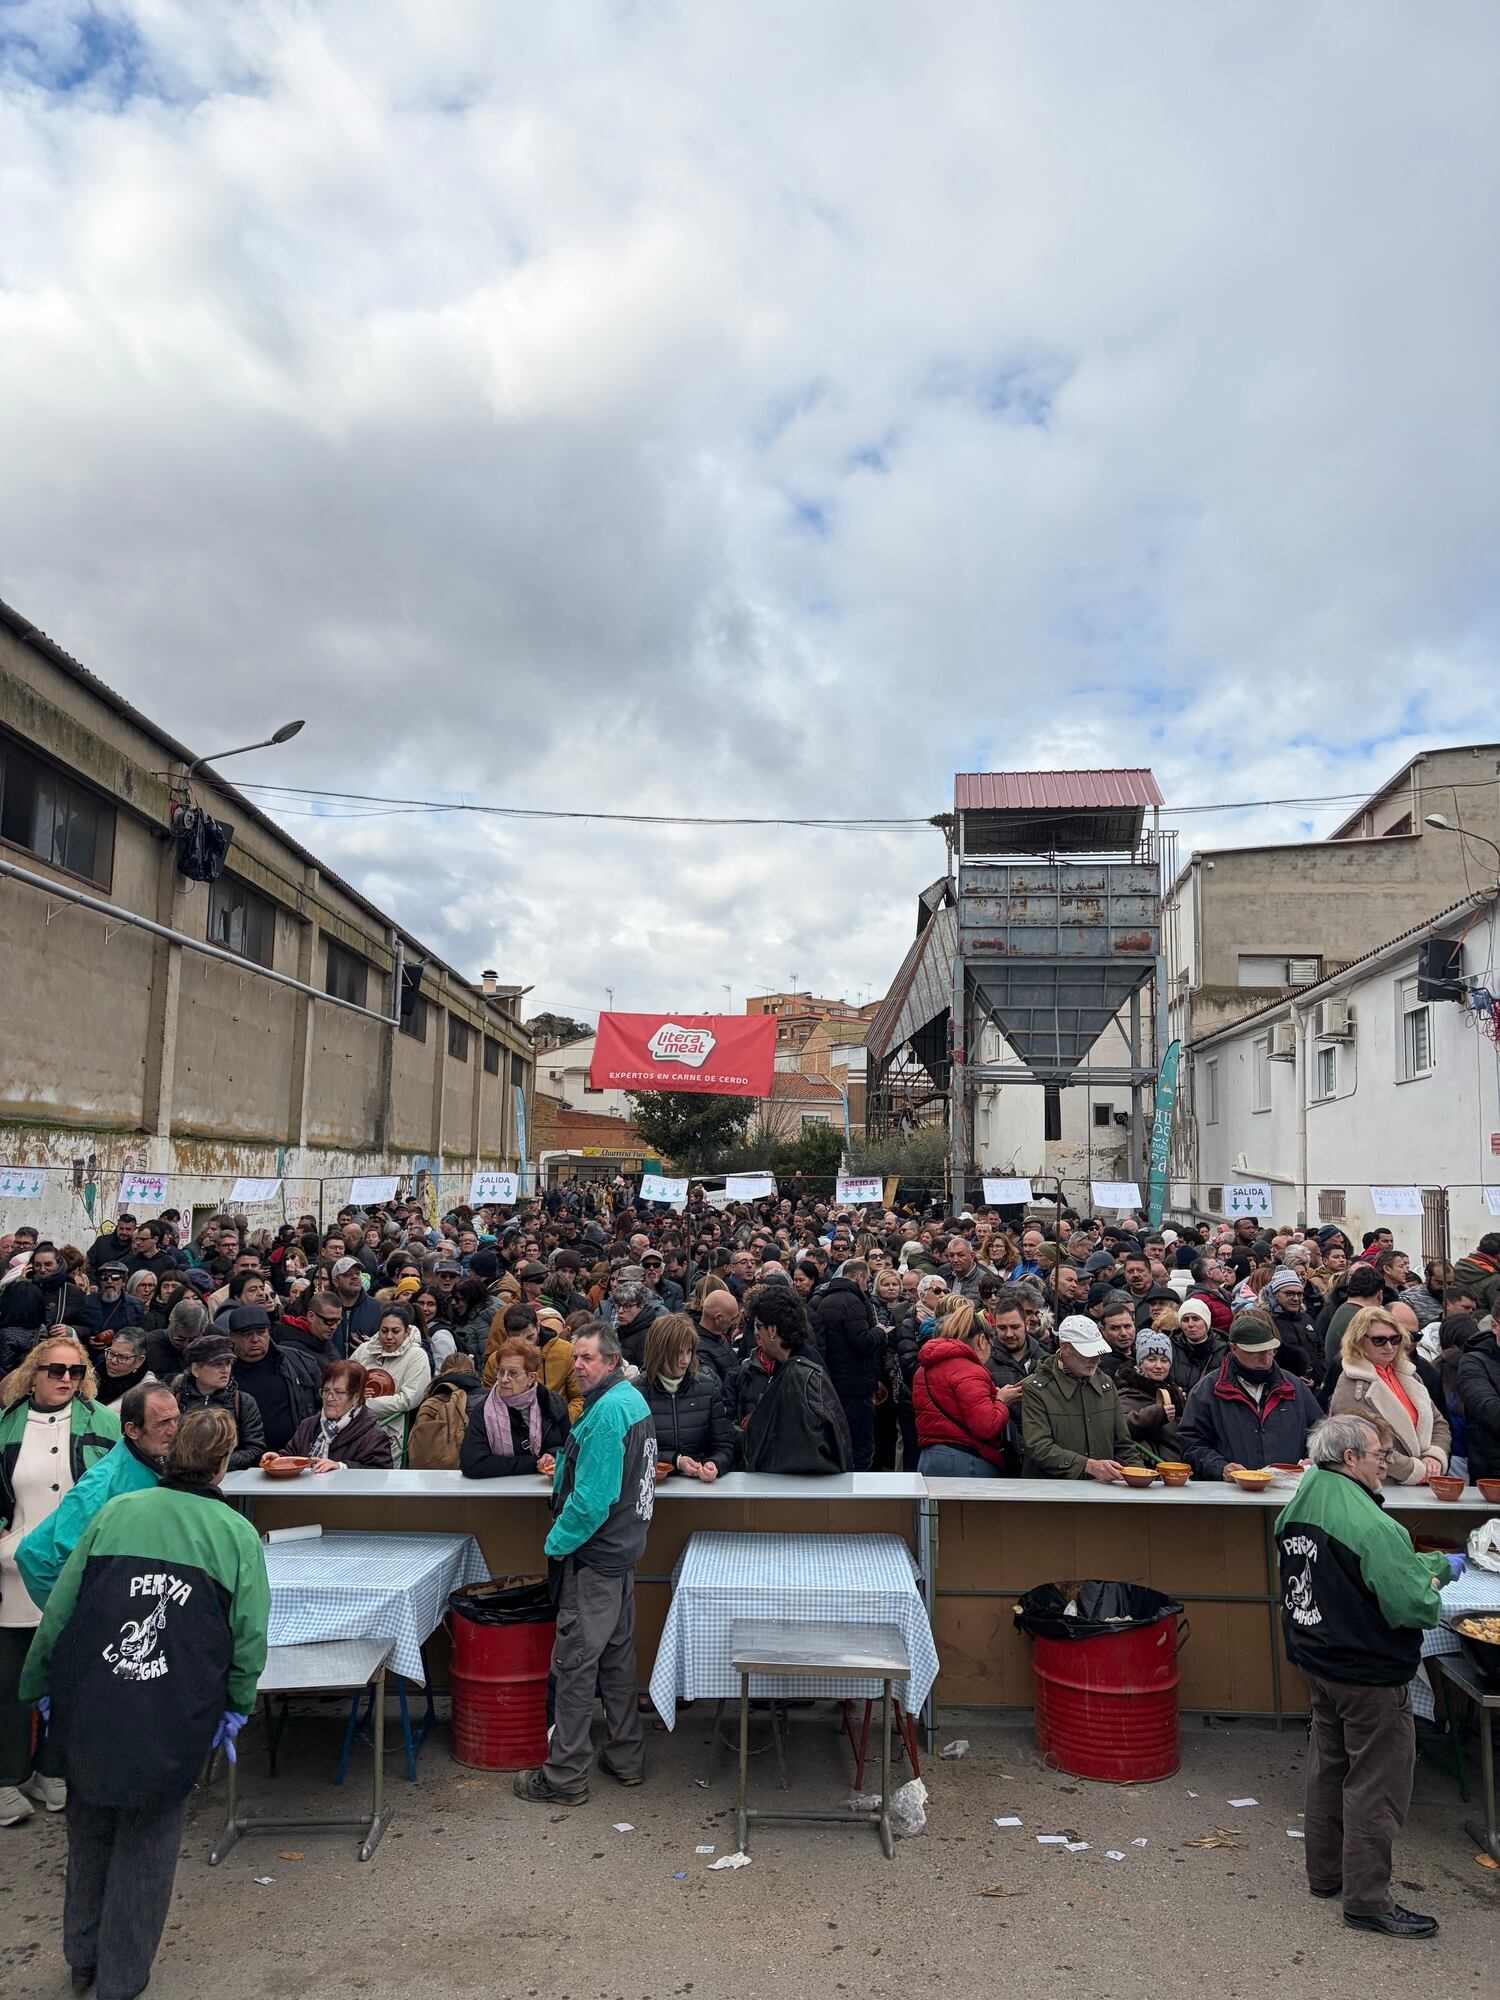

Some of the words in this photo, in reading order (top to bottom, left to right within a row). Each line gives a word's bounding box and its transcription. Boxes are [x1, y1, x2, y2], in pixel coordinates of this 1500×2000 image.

[663, 1041, 706, 1053] meat
[609, 1071, 655, 1079] EXPERTOS
[671, 1073, 702, 1081] CARNE
[704, 1074, 716, 1082] DE
[718, 1075, 749, 1085] CERDO
[131, 1176, 161, 1184] SALIDA
[480, 1176, 510, 1184] SALIDA
[1233, 1188, 1264, 1196] SALIDA
[1148, 1346, 1168, 1356] NY
